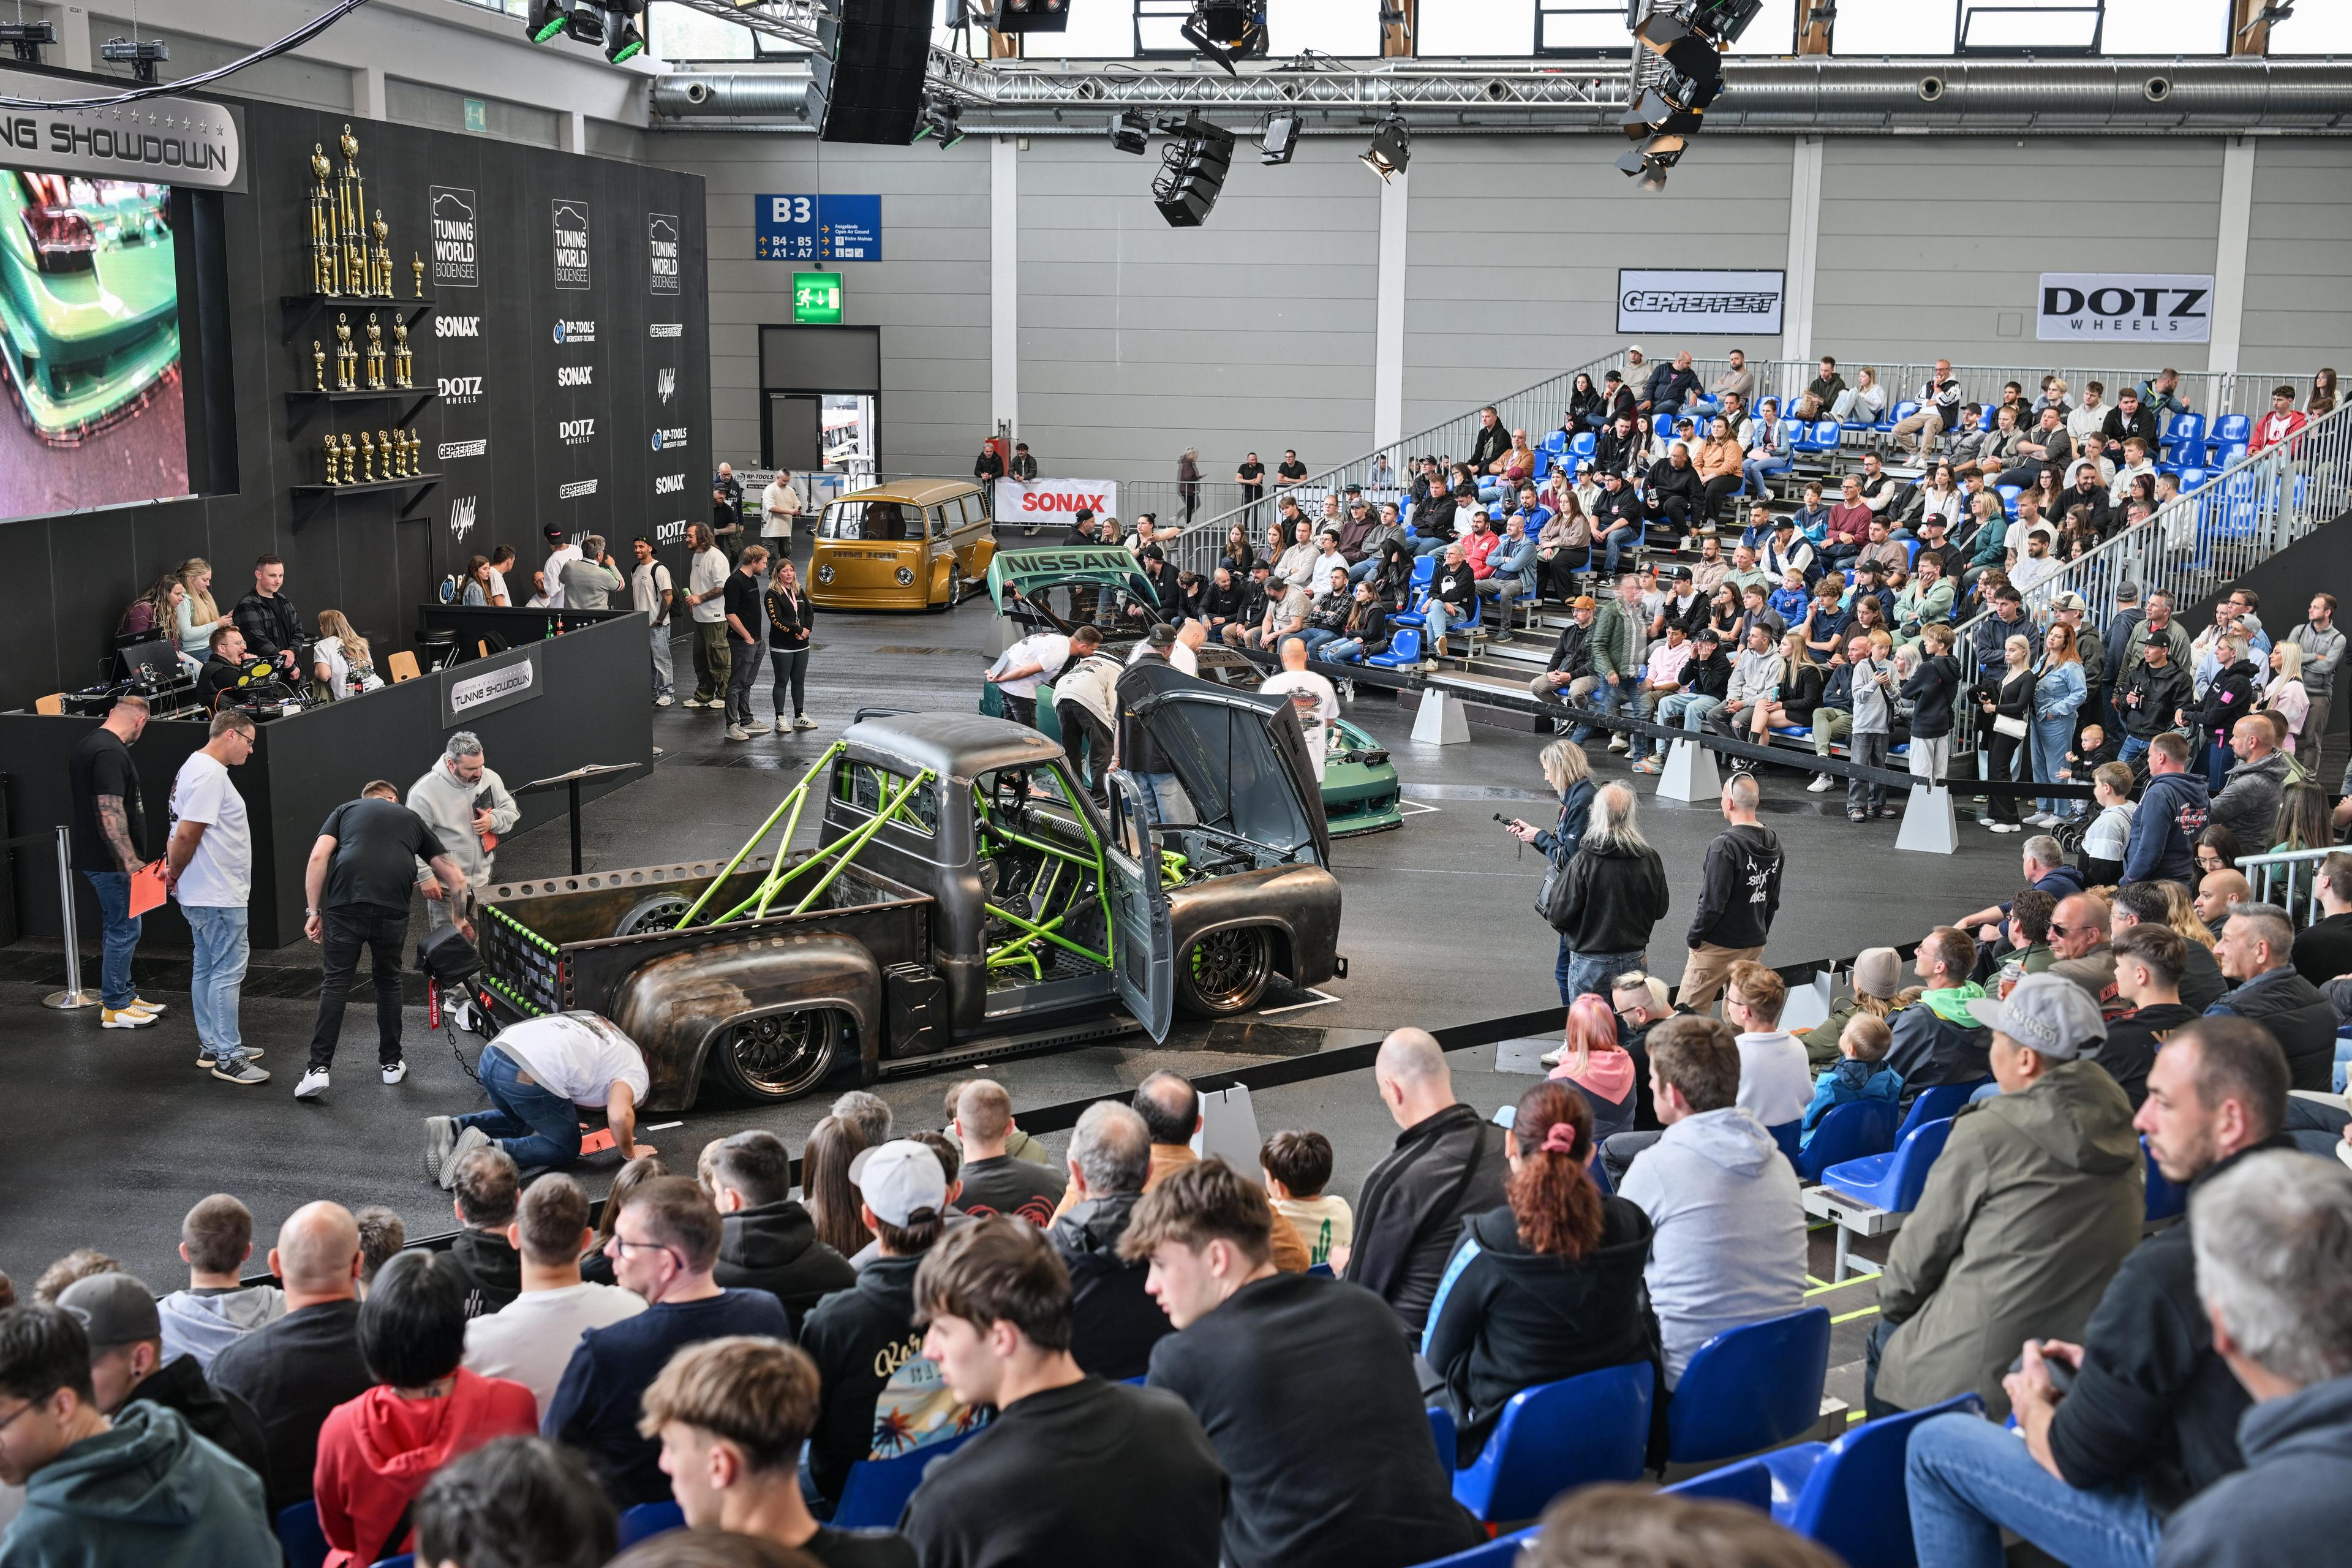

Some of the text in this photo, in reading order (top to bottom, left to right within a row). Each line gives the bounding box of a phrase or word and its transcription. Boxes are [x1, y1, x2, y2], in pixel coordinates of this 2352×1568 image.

[50, 123, 227, 172] SHOWDOWN
[772, 197, 811, 223] B3
[434, 219, 473, 241] TUNING
[556, 230, 587, 248] TUNING
[651, 241, 677, 257] TUNING
[772, 236, 787, 246] B4
[797, 236, 812, 246] B5
[435, 240, 475, 262] WORLD
[556, 249, 587, 268] WORLD
[772, 248, 787, 257] A1
[797, 248, 812, 258] A7
[436, 263, 475, 278] BODENSEE
[557, 268, 587, 282] BODENSEE
[652, 258, 677, 275] WORLD
[652, 276, 677, 288] BODENSEE
[1623, 290, 1779, 313] GEPFEFFERT
[2043, 287, 2207, 317] DOTZ
[435, 315, 479, 337] SONAX
[566, 321, 595, 333] RP-TOOLS
[2071, 319, 2178, 331] WHEELS
[558, 366, 592, 386] SONAX
[437, 377, 483, 396] DOTZ
[446, 396, 477, 404] WHEELS
[559, 419, 595, 439] DOTZ
[663, 428, 687, 441] RP-TOOLS
[566, 436, 589, 445] WHEELS
[656, 473, 684, 495] SONAX
[1022, 492, 1105, 513] SONAX
[657, 520, 687, 540] DOTZ
[662, 537, 682, 546] WHEELS
[1005, 552, 1128, 573] NISSAN
[455, 684, 477, 695] EUROPEAN
[455, 674, 530, 706] TUNING SHOWDOWN
